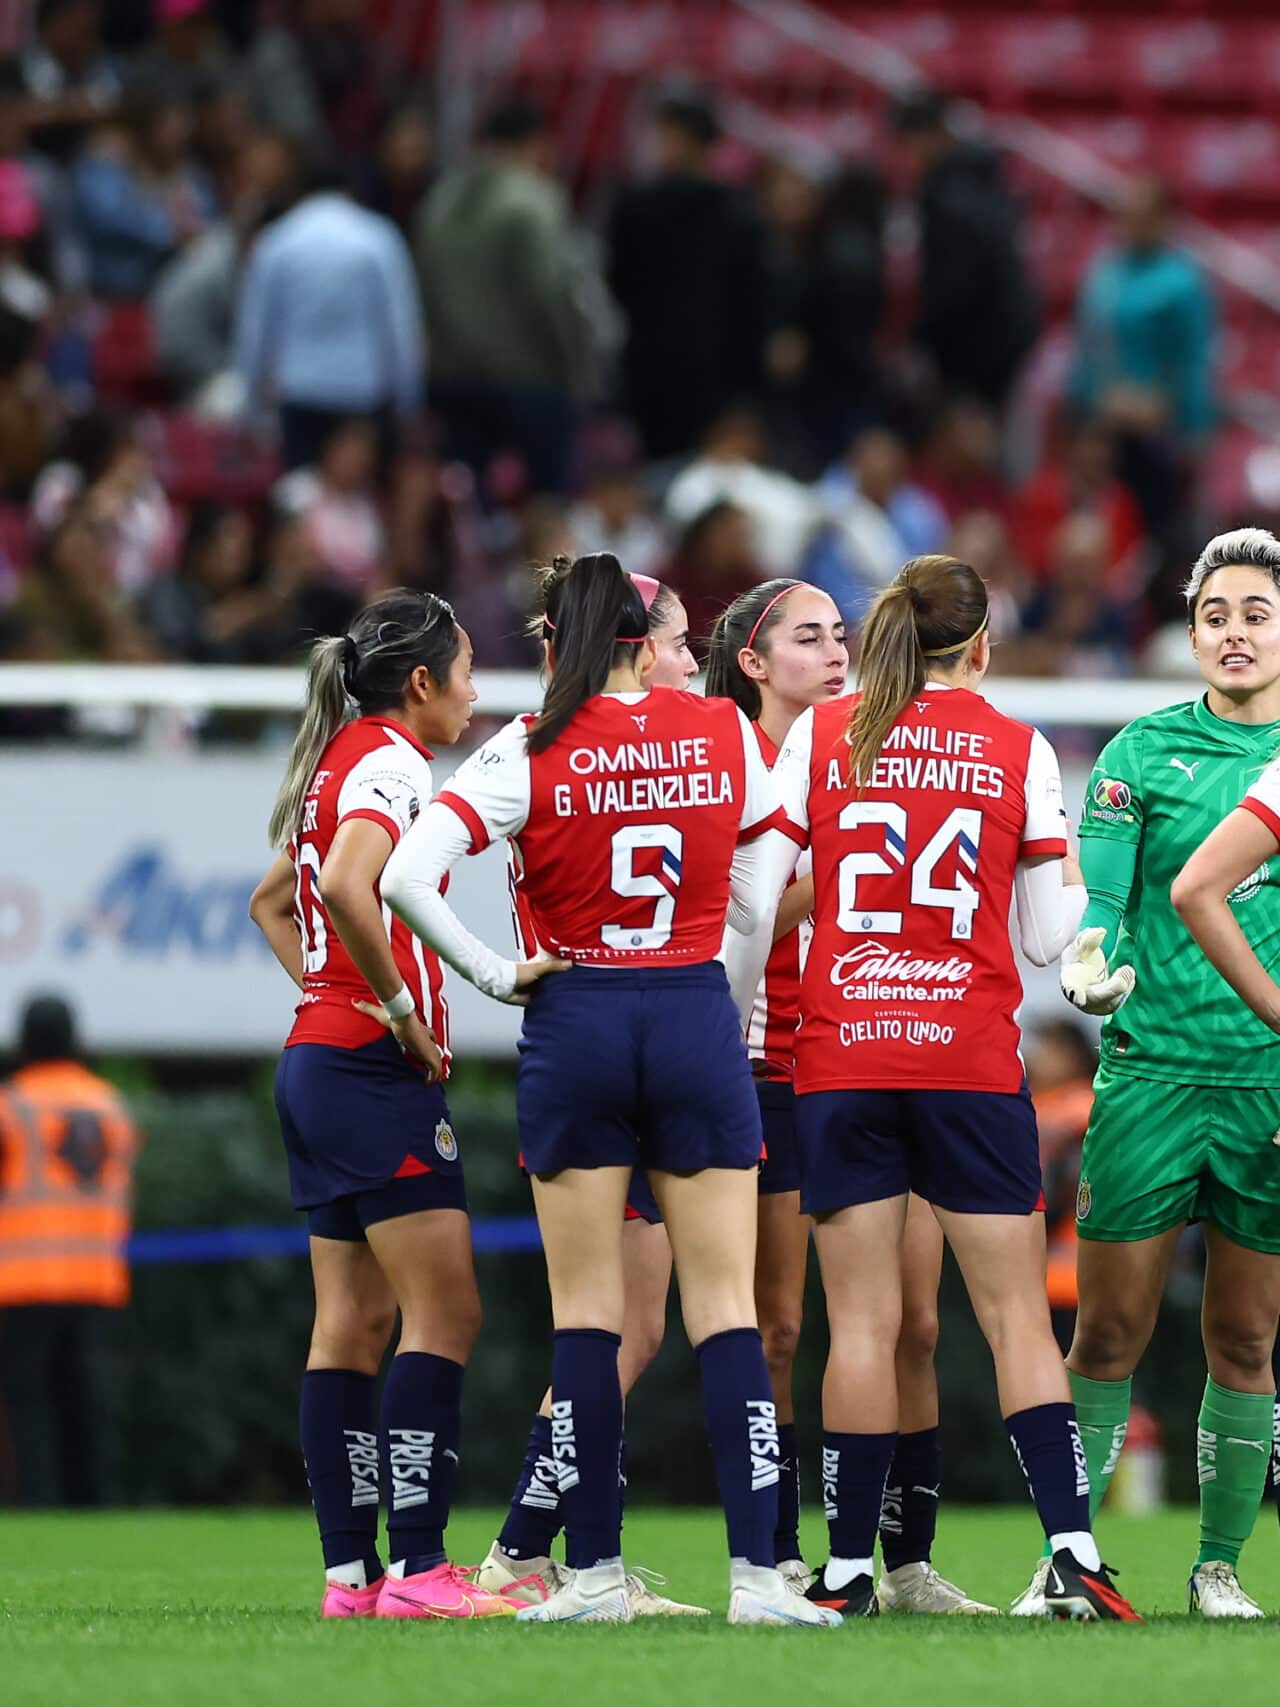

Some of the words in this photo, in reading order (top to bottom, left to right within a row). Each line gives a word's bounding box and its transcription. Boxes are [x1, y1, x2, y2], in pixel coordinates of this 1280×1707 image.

[569, 738, 709, 774] OMNILIFE
[843, 726, 985, 758] MNILIFE
[554, 784, 578, 816] G.
[585, 771, 733, 814] VALENZUELA
[826, 758, 848, 791] A.
[855, 757, 1004, 798] CERVANTES
[601, 823, 684, 951] 9
[836, 801, 984, 939] 24
[830, 939, 974, 986] Caliente
[842, 981, 966, 1001] caliente.mx
[840, 1019, 902, 1047] CIELITO
[905, 1020, 954, 1046] LINDO
[343, 1430, 380, 1507] PRISA
[746, 1400, 780, 1491] PRISA
[388, 1429, 436, 1511] PRISA
